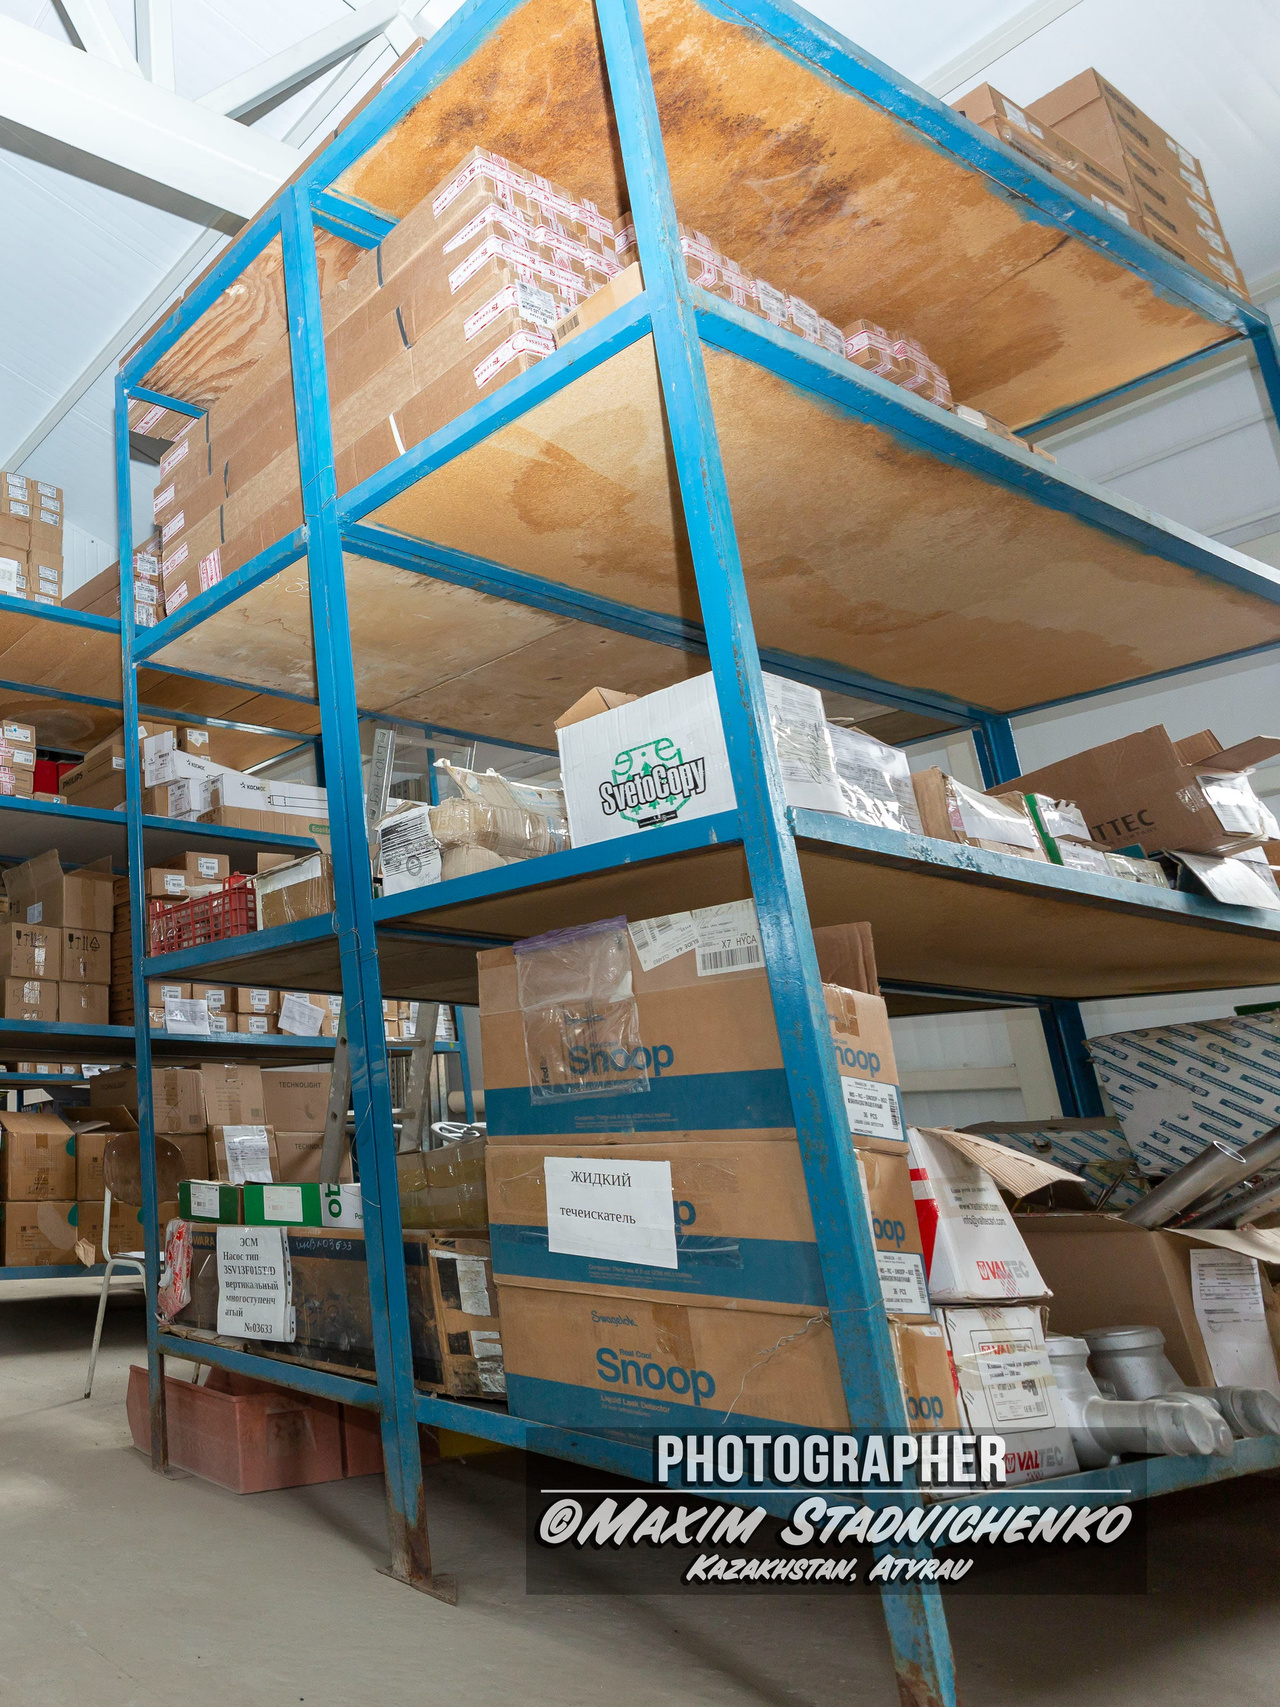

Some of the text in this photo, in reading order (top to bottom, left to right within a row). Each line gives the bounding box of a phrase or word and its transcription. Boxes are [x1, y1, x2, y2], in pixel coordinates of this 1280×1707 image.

[62, 771, 84, 790] PHILIPS
[598, 757, 707, 816] SvetoCopy
[721, 935, 758, 949] X7 HYCA
[570, 1044, 675, 1077] Snoop
[834, 1045, 881, 1078] noop
[559, 1206, 636, 1225] течеискатель
[239, 1237, 259, 1247] ЭСМ
[872, 1218, 906, 1249] oop
[223, 1251, 260, 1262] Насос тип
[985, 1260, 1030, 1280] VALTEC
[225, 1280, 280, 1291] вертикальный
[225, 1294, 277, 1306] многоступенч
[224, 1307, 244, 1317] атый
[591, 1310, 638, 1327] Swagelok
[244, 1322, 273, 1334] №03633
[619, 1348, 652, 1359] Real Cool
[596, 1347, 716, 1406] Snoop
[600, 1394, 670, 1413] Liquid Leak Detector
[906, 1392, 944, 1426] oop
[1017, 1446, 1064, 1471] VALTEC
